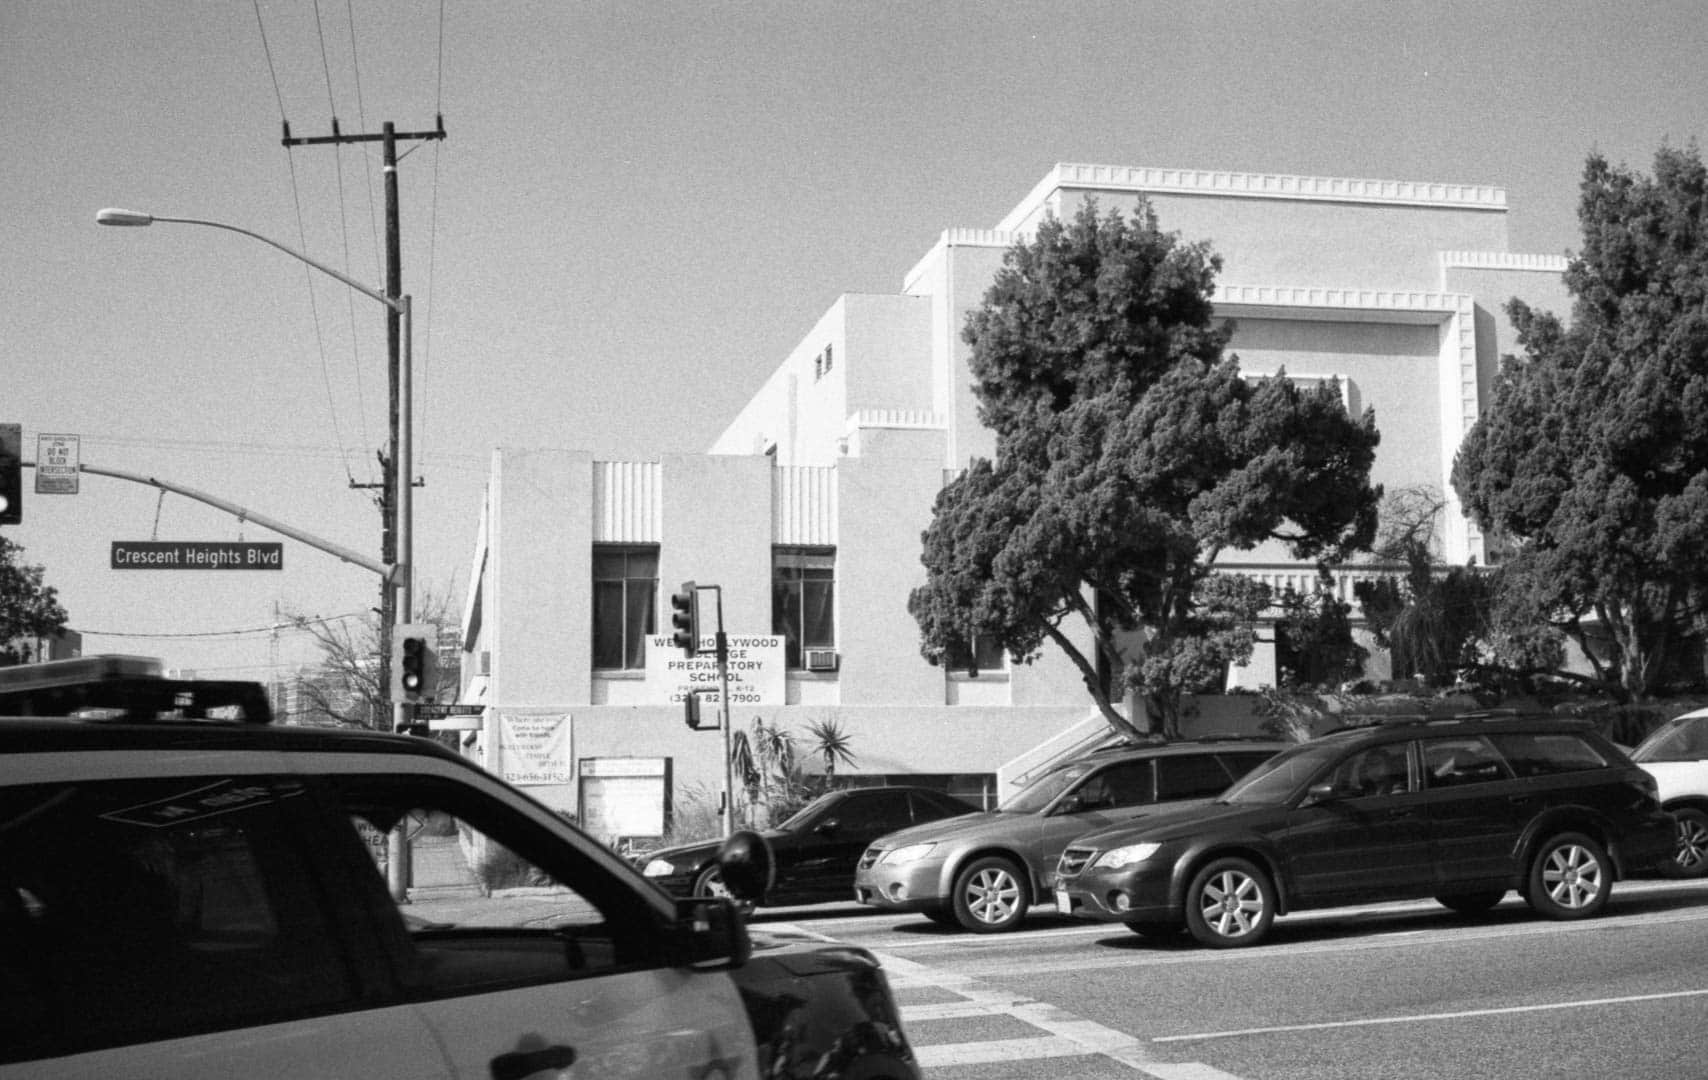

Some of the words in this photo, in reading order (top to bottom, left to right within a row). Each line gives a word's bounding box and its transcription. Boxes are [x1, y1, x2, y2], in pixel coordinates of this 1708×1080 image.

[115, 548, 179, 564] Crescent
[186, 548, 241, 568] Heights
[247, 548, 279, 564] Blvd
[698, 638, 779, 648] HOYWOOD
[667, 661, 763, 670] PREPARTORY
[704, 693, 761, 702] 82-7900
